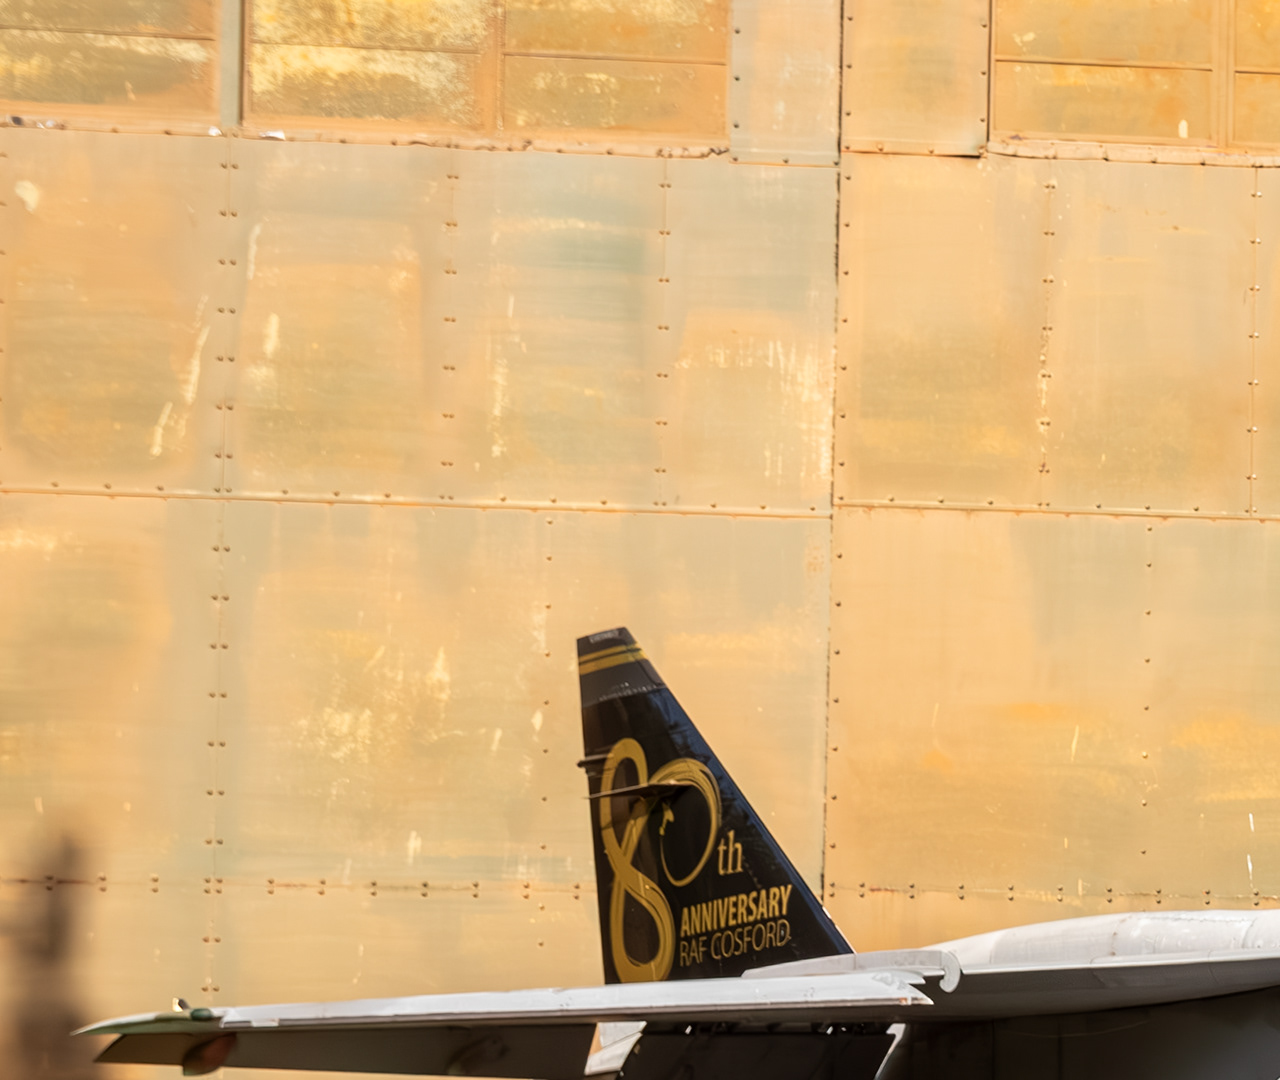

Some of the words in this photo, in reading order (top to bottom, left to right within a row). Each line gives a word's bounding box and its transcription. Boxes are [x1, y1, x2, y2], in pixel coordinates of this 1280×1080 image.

[680, 884, 792, 937] ANNIVERSARY
[680, 936, 708, 967] RAF
[711, 919, 791, 960] COSFORD
